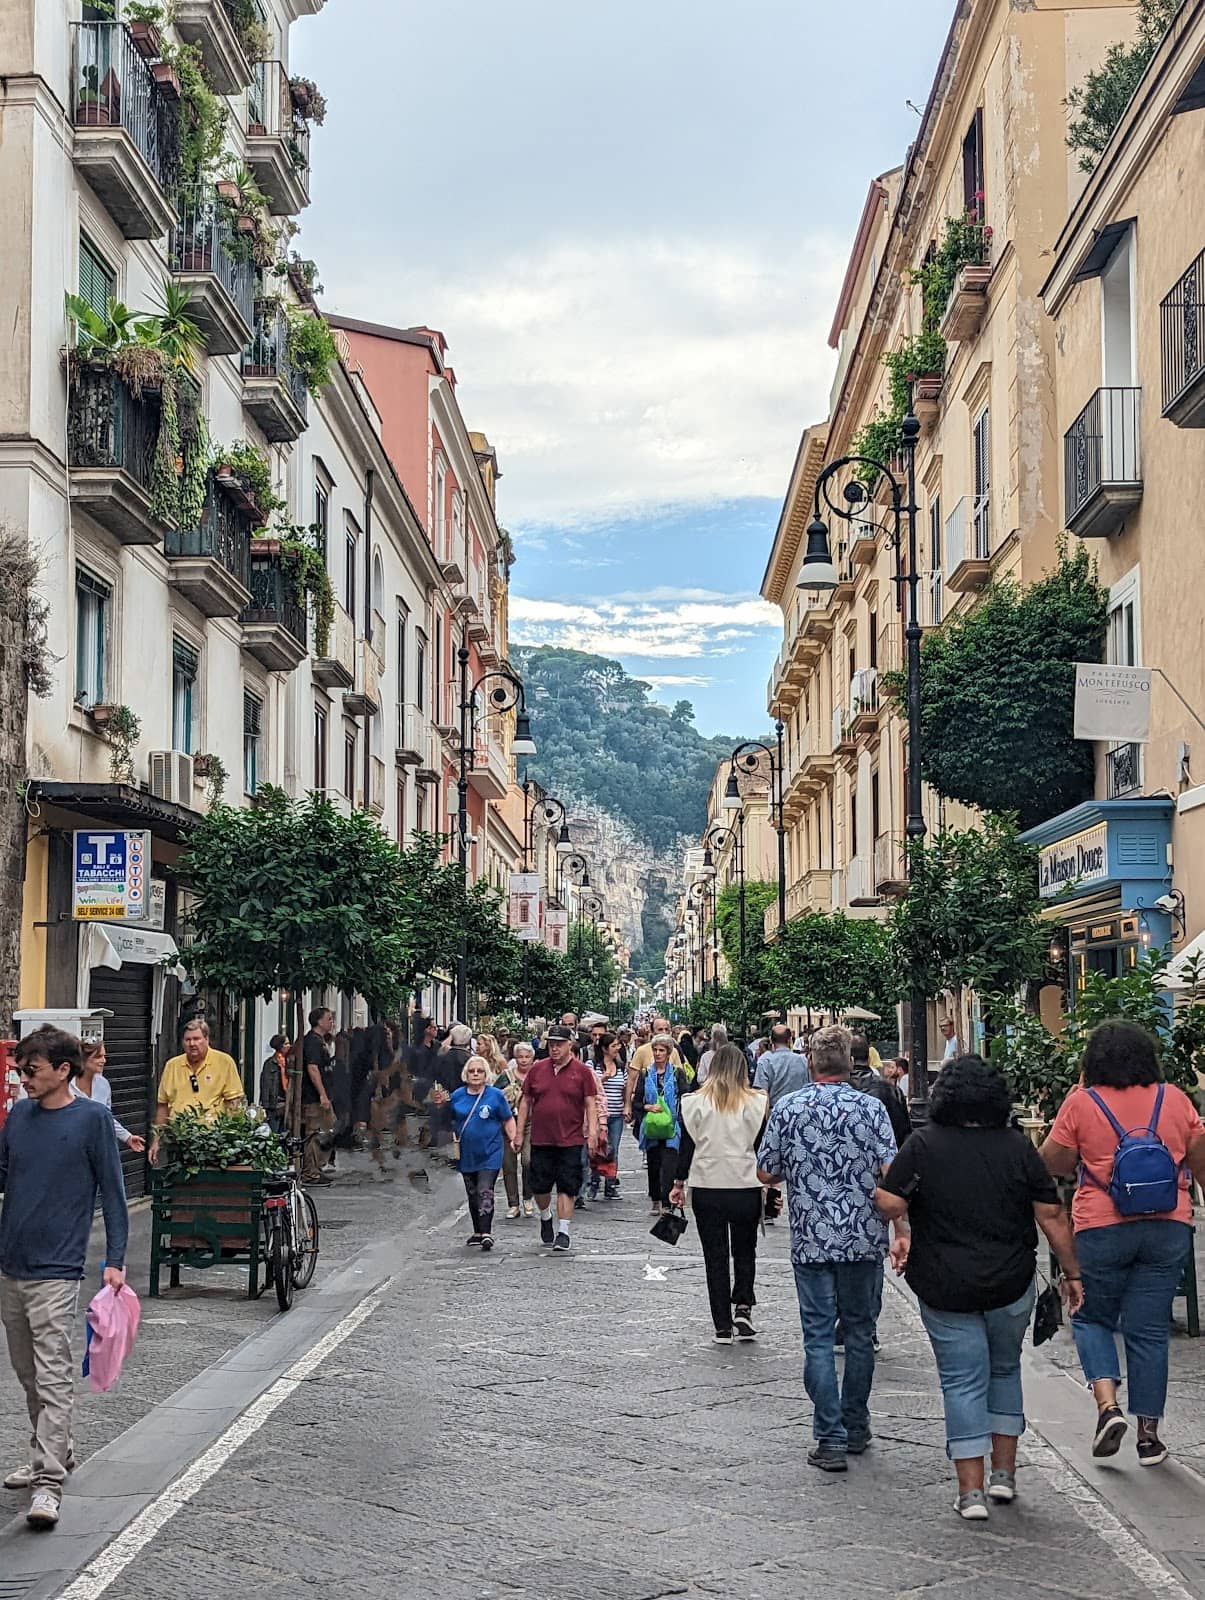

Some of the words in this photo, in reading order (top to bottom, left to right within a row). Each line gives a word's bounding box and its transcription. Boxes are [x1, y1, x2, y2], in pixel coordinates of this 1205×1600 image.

[1091, 671, 1137, 679] PALAZZO
[1078, 678, 1150, 691] MONTEFUSCO
[88, 836, 115, 864] T
[130, 841, 142, 899] LOTTO
[1040, 858, 1049, 887] La
[1049, 850, 1076, 882] Maison
[1077, 844, 1103, 875] Douce
[78, 869, 124, 877] TABACCHI
[79, 896, 97, 904] Win
[77, 907, 89, 915] SELF
[89, 907, 108, 915] SERVICE
